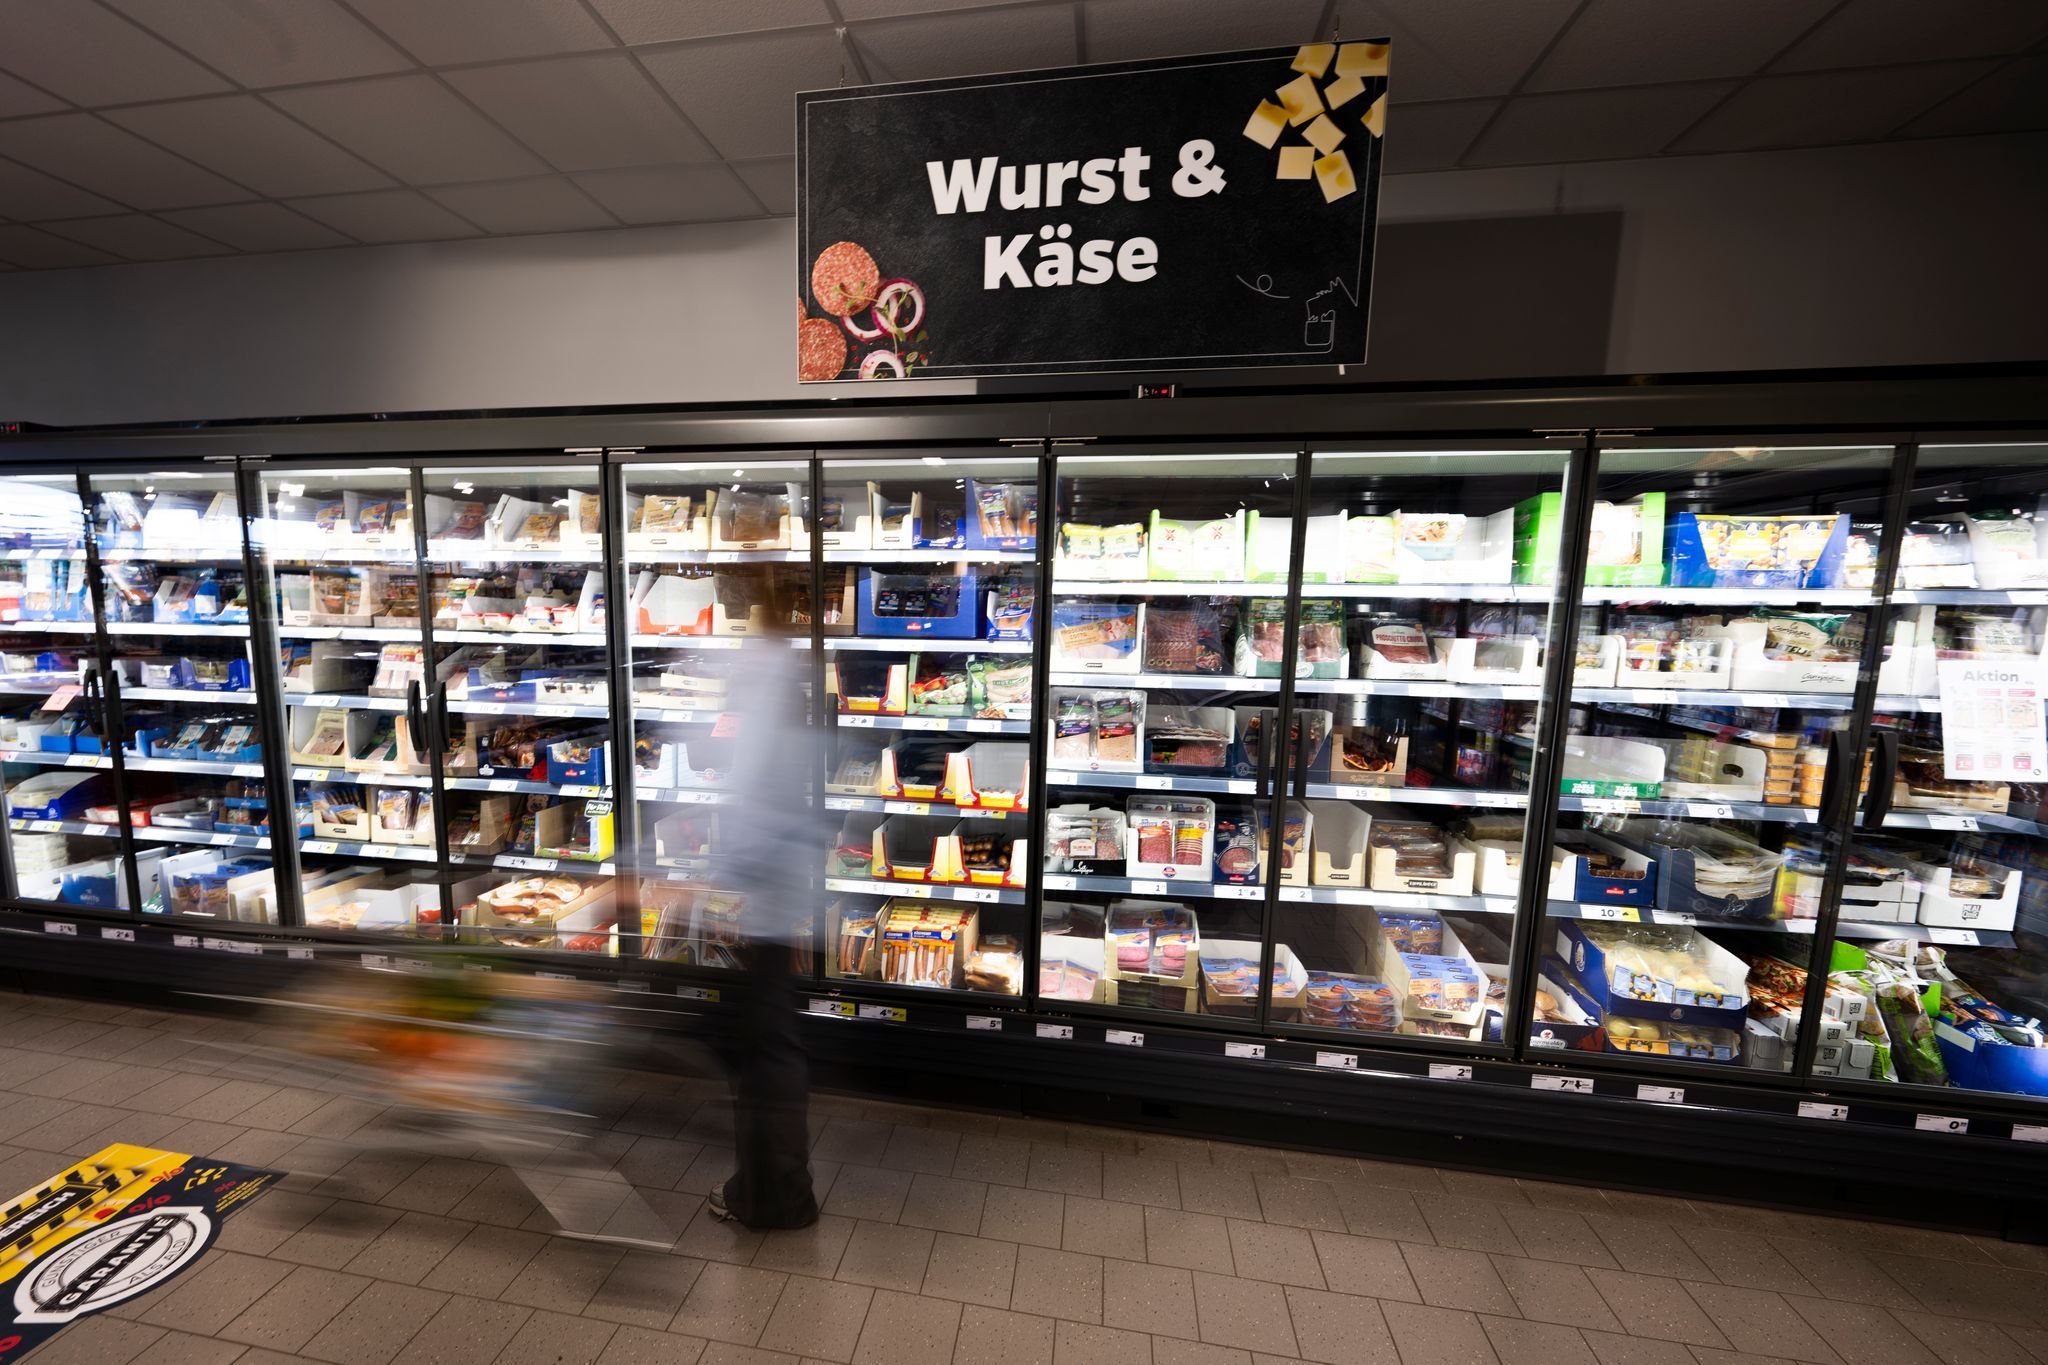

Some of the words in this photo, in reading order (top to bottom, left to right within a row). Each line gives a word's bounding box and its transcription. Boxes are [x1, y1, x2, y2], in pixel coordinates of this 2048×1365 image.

[926, 146, 1151, 216] Wurst
[1171, 138, 1227, 199] &
[983, 223, 1159, 291] Käse
[1962, 670, 2020, 682] Aktion
[0, 1192, 76, 1240] EREICH
